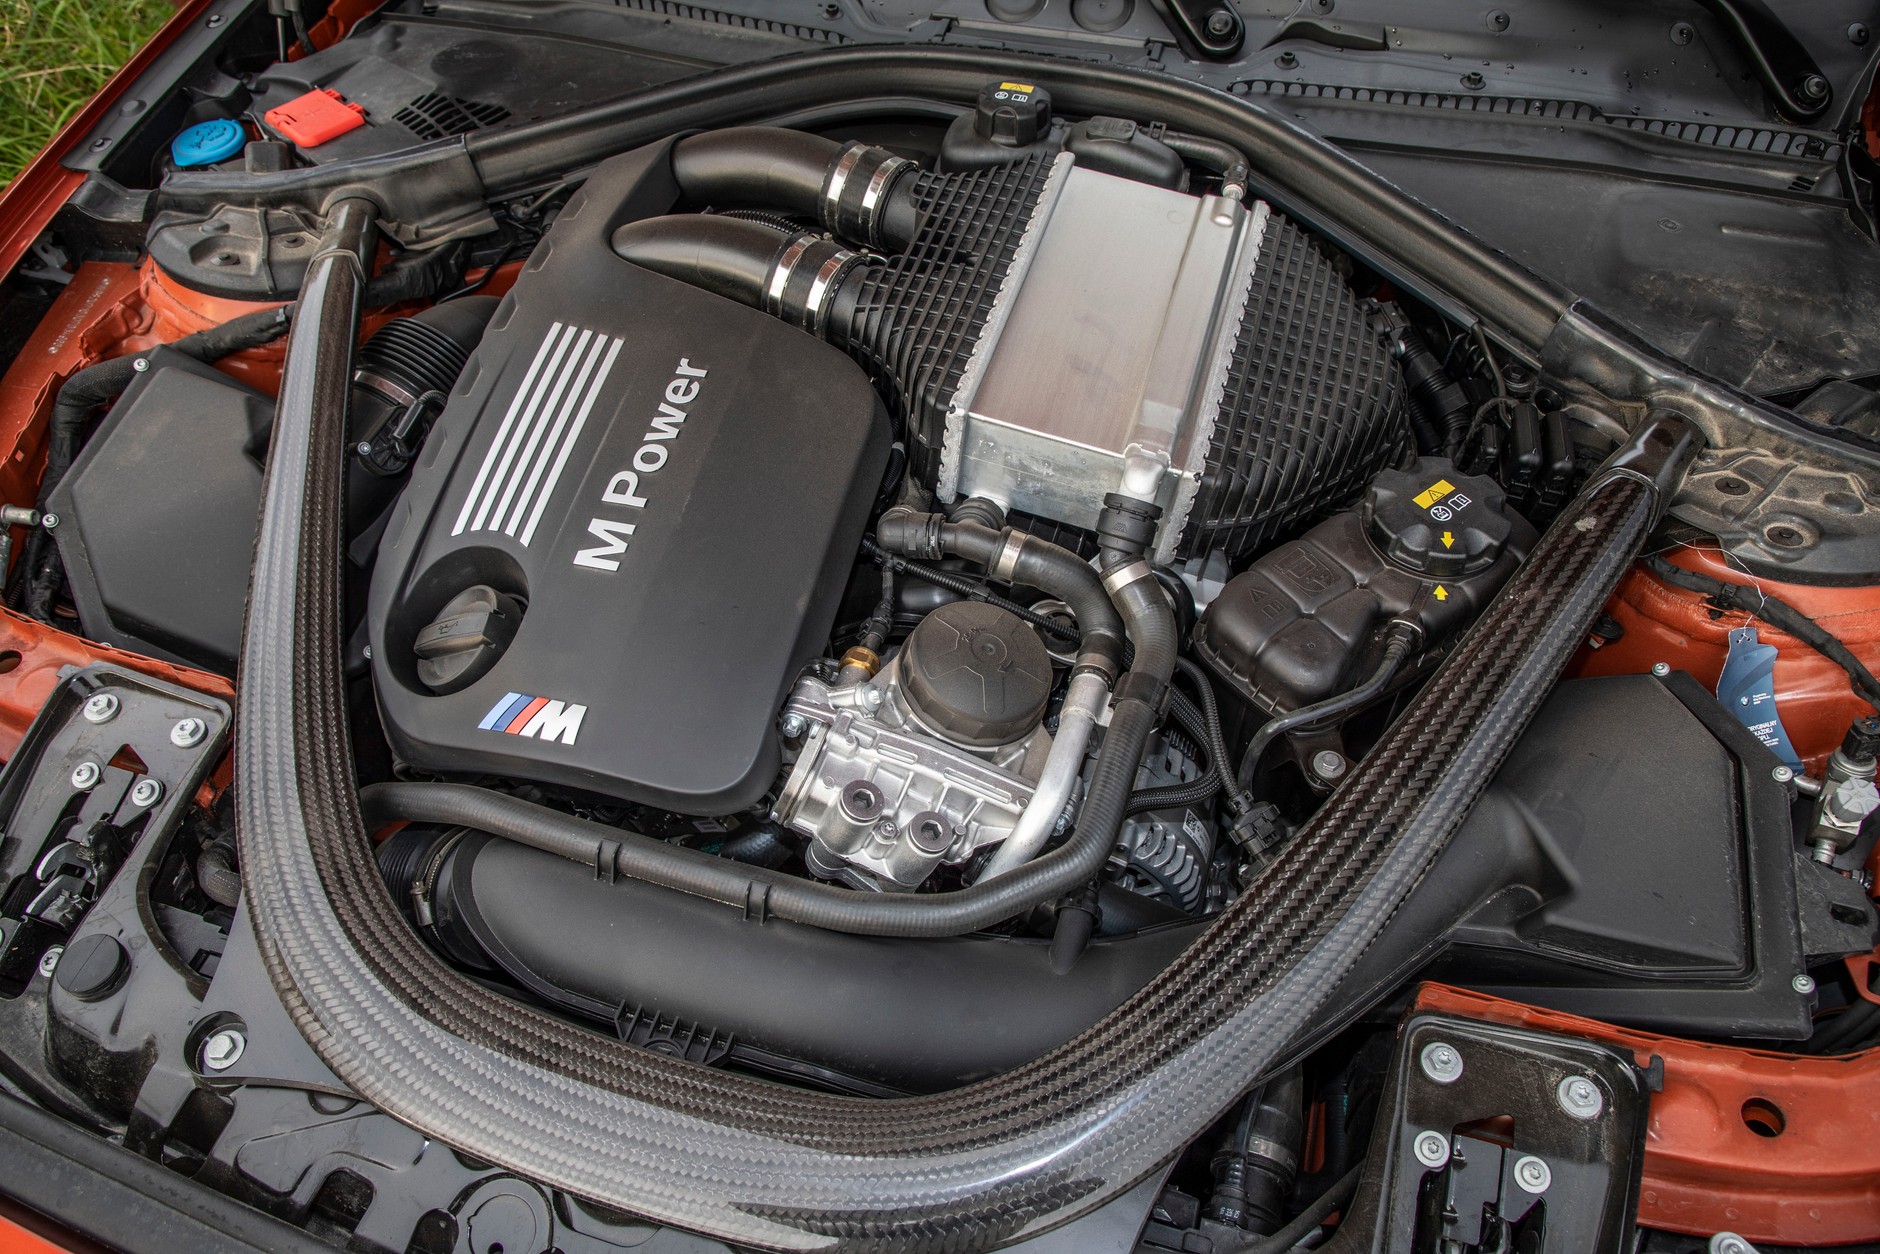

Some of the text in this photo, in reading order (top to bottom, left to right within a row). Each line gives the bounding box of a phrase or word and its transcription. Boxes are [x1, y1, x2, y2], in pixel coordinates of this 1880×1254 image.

[573, 358, 708, 572] M Power
[518, 699, 588, 746] M
